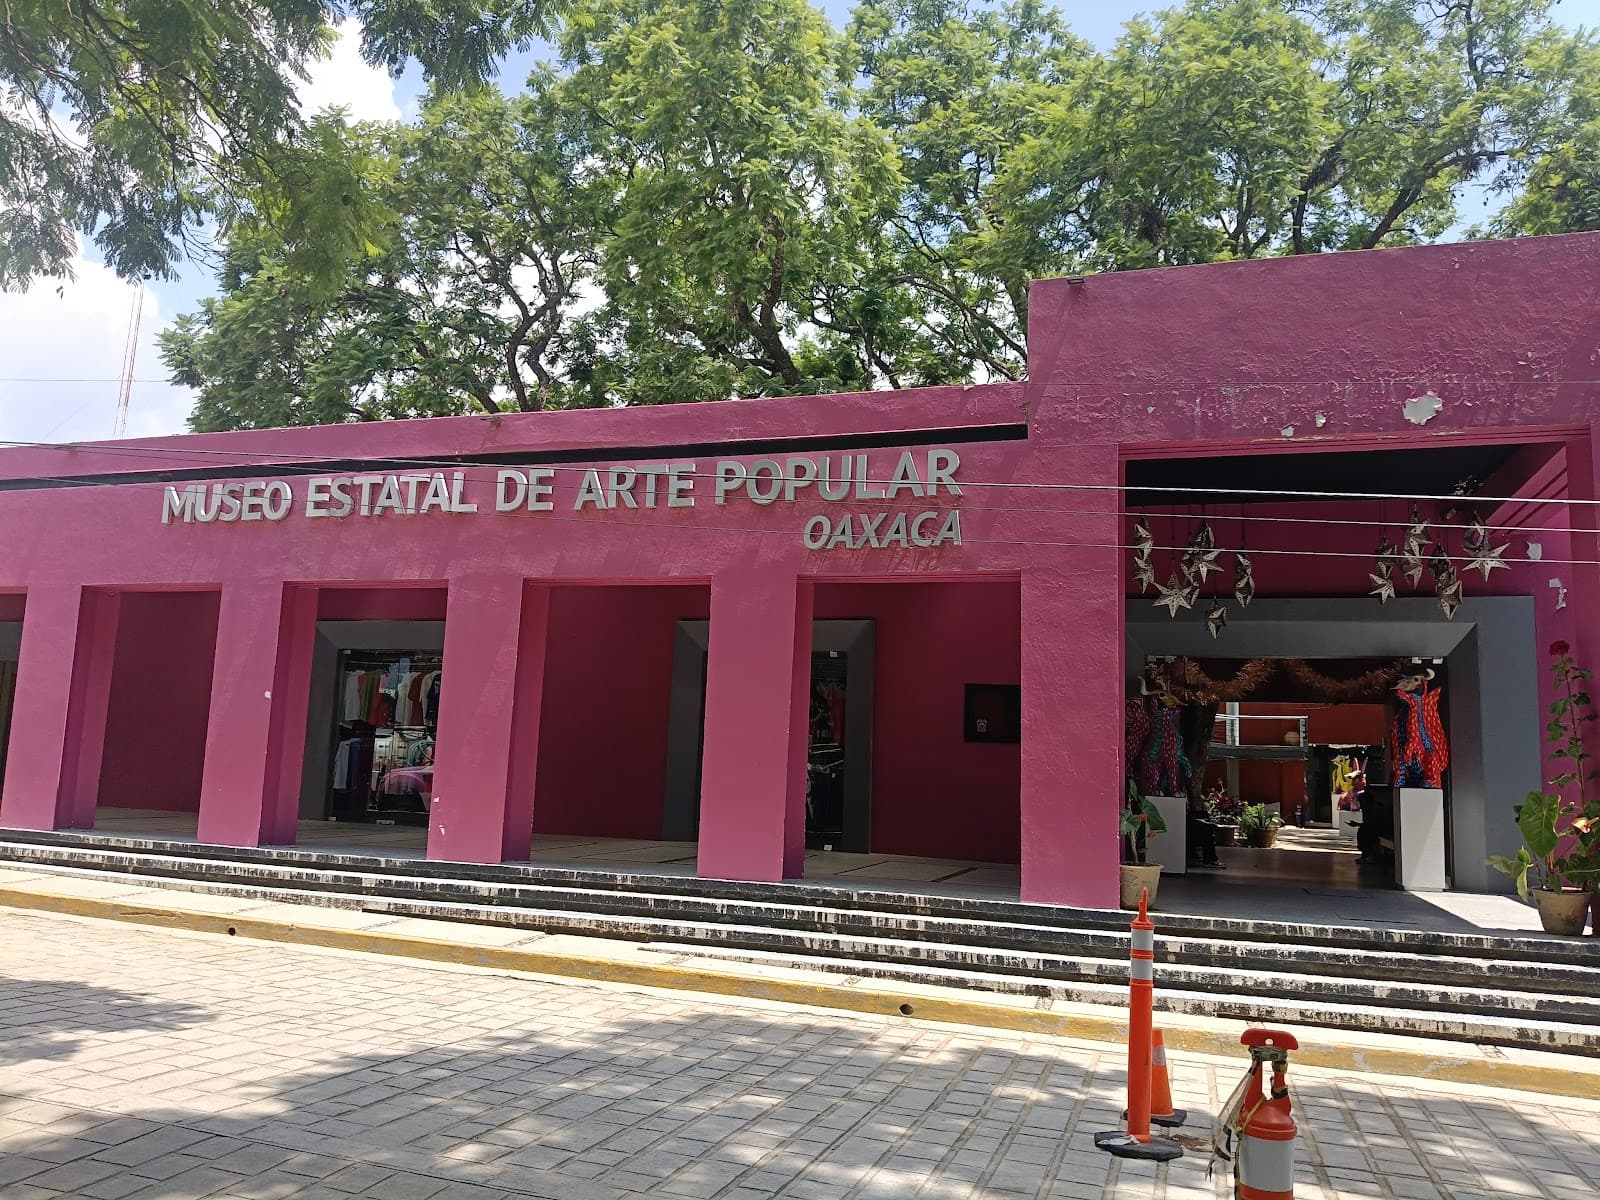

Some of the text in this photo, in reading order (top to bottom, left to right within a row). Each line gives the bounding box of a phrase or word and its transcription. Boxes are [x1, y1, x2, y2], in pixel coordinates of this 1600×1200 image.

[161, 449, 963, 524] MUSEO ESTATAL DE ARTE POPULAR
[803, 509, 962, 551] OAXACA
